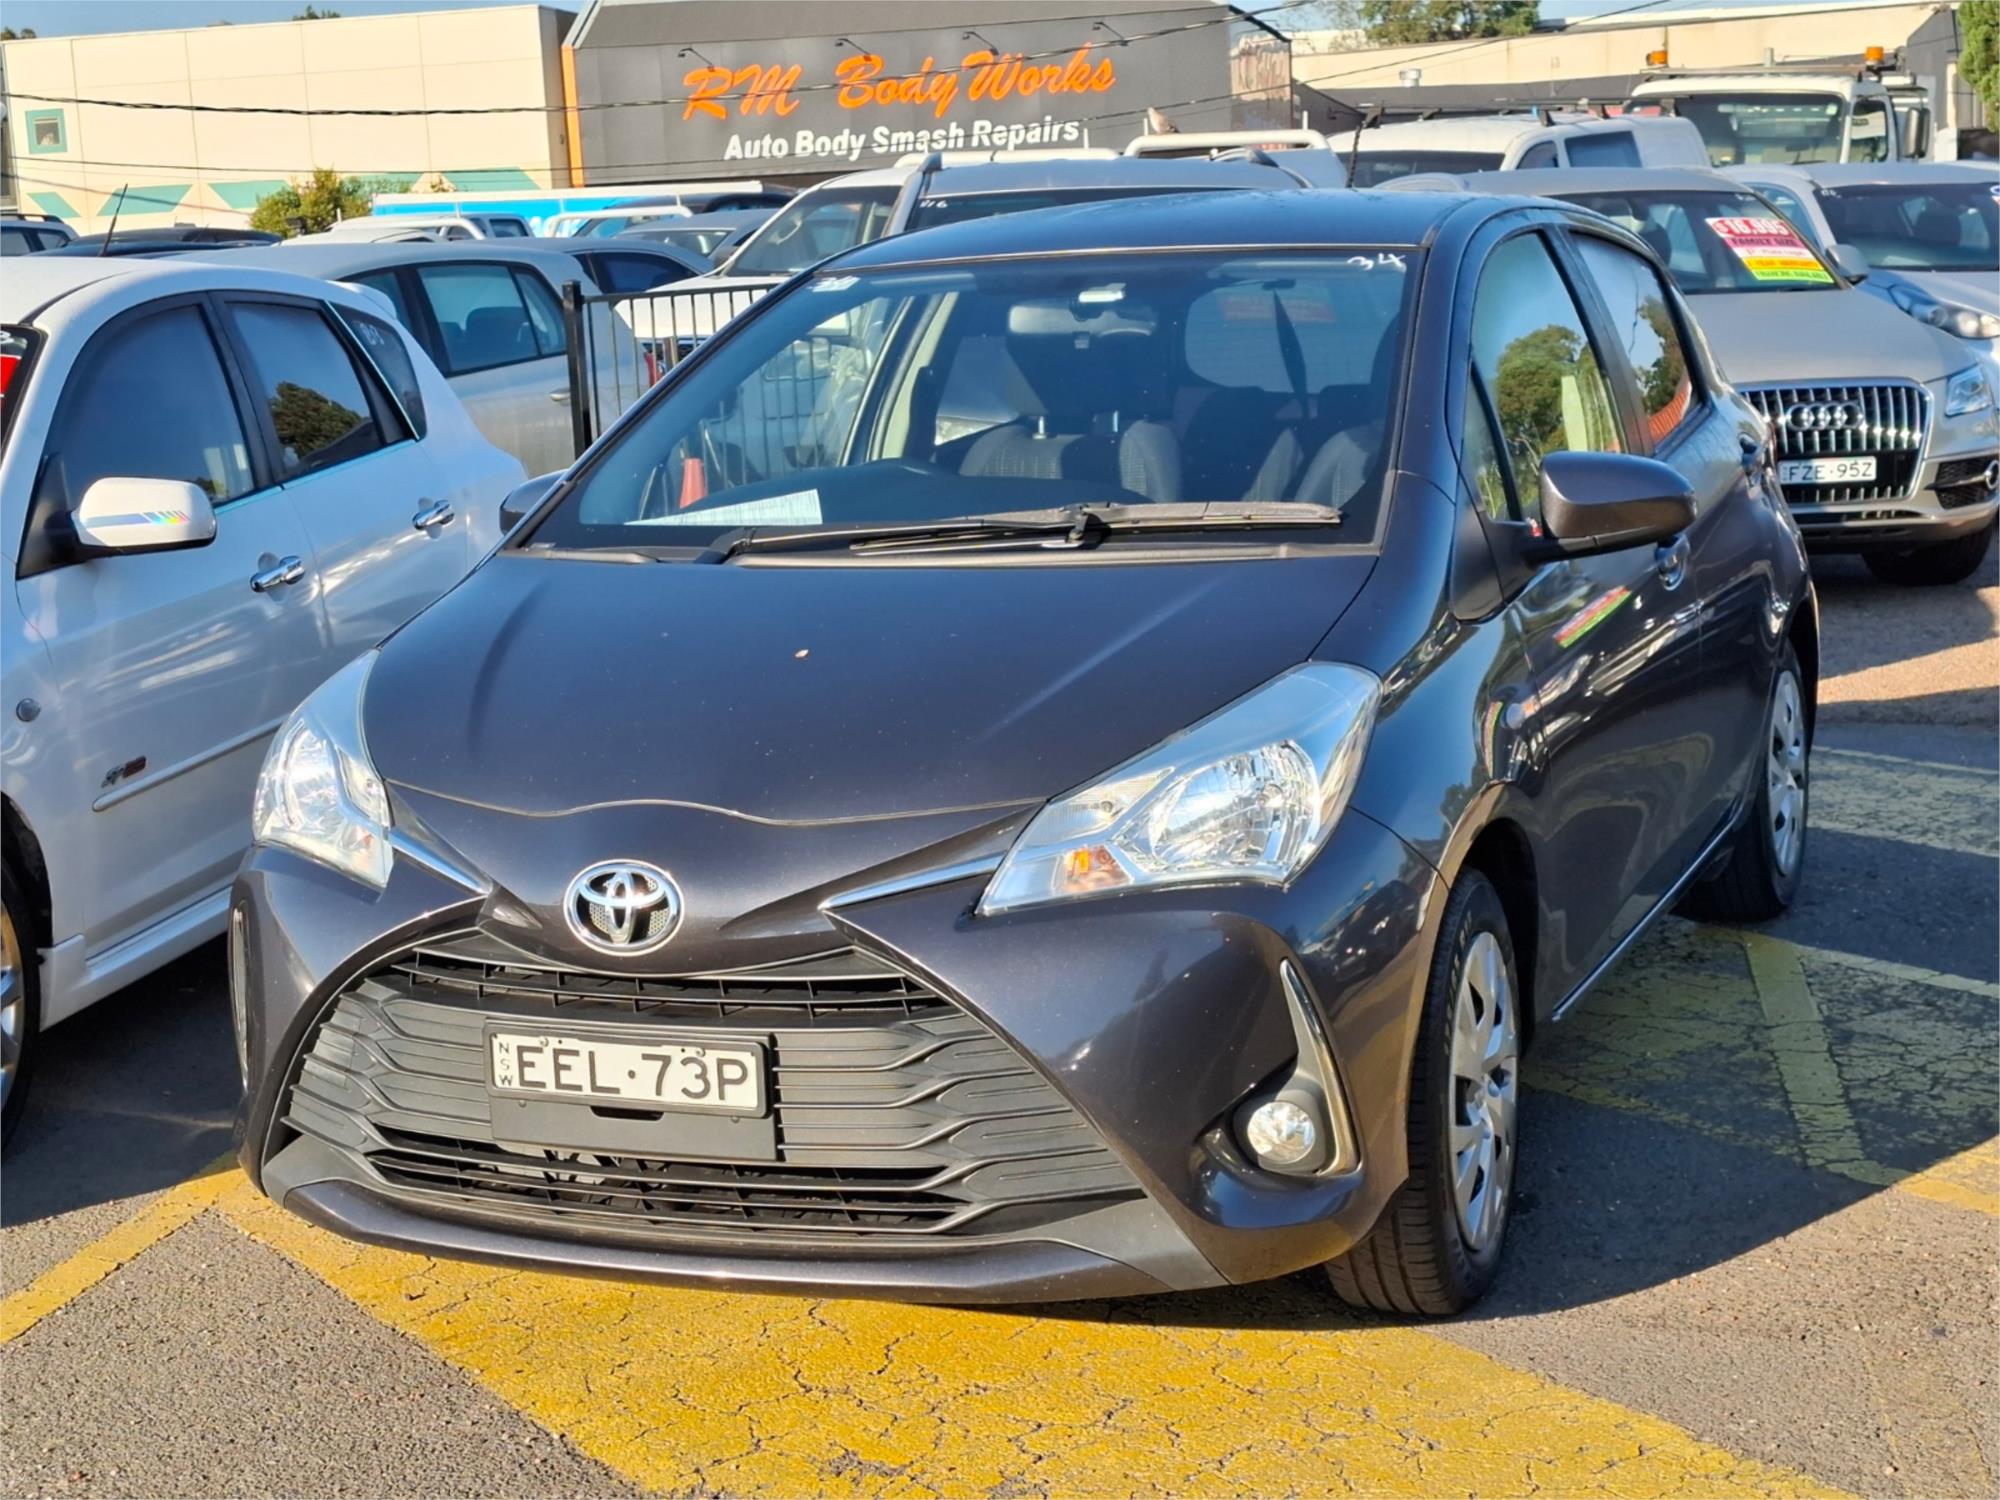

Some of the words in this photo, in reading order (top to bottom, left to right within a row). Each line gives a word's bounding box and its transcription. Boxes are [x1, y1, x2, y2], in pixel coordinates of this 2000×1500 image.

[682, 63, 802, 120] RM
[835, 53, 962, 118] Body
[962, 41, 1116, 101] Works
[723, 133, 789, 160] Auto
[795, 128, 866, 161] Body
[872, 122, 964, 153] Smash
[972, 115, 1080, 151] Repairs
